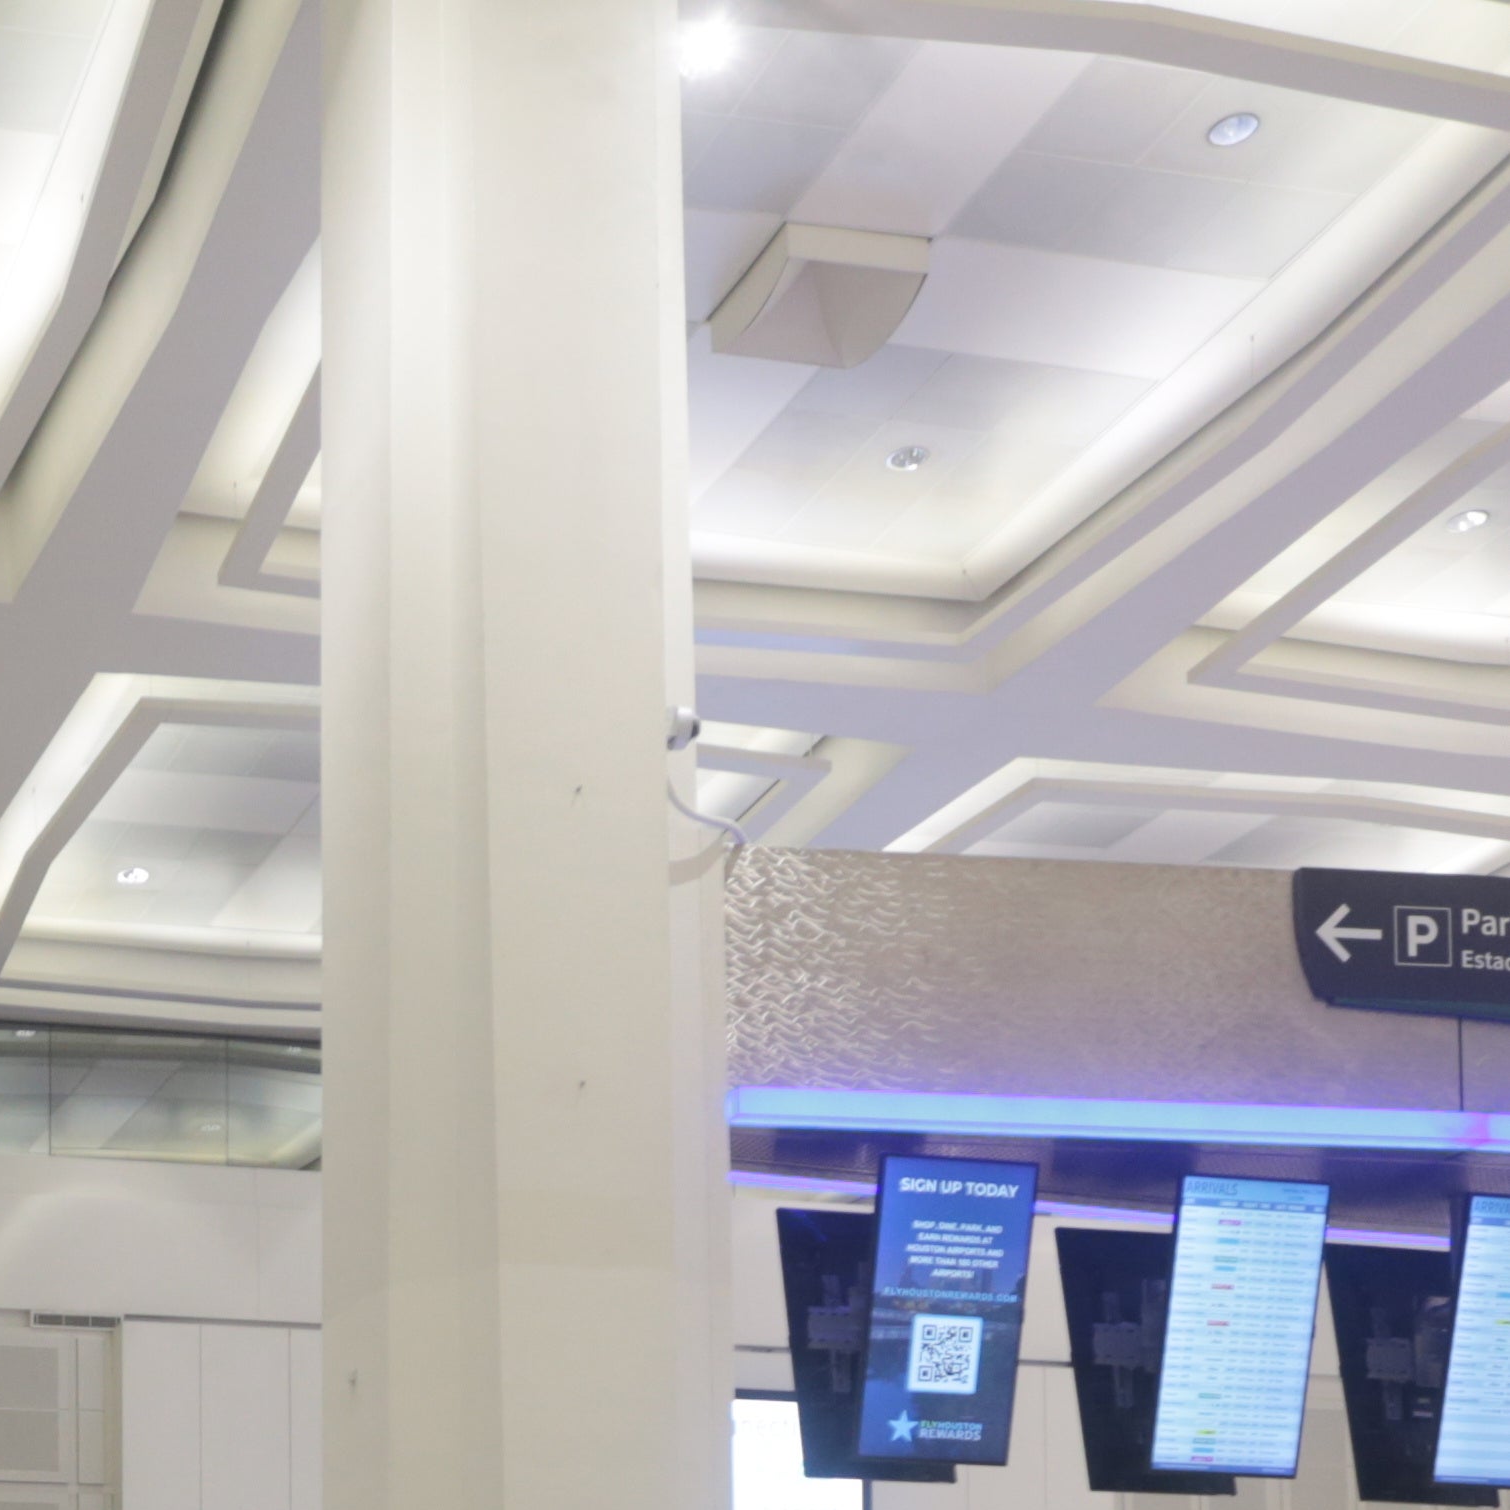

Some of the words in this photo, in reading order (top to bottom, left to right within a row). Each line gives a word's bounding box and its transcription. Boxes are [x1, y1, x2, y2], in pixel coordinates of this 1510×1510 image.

[1461, 907, 1510, 937] Par
[1406, 914, 1439, 958] P
[898, 1177, 937, 1194] SIGN
[940, 1180, 963, 1195] UP
[965, 1182, 1019, 1199] TODAY
[1185, 1178, 1239, 1196] ARRIVALS
[918, 1428, 982, 1441] REWARDS
